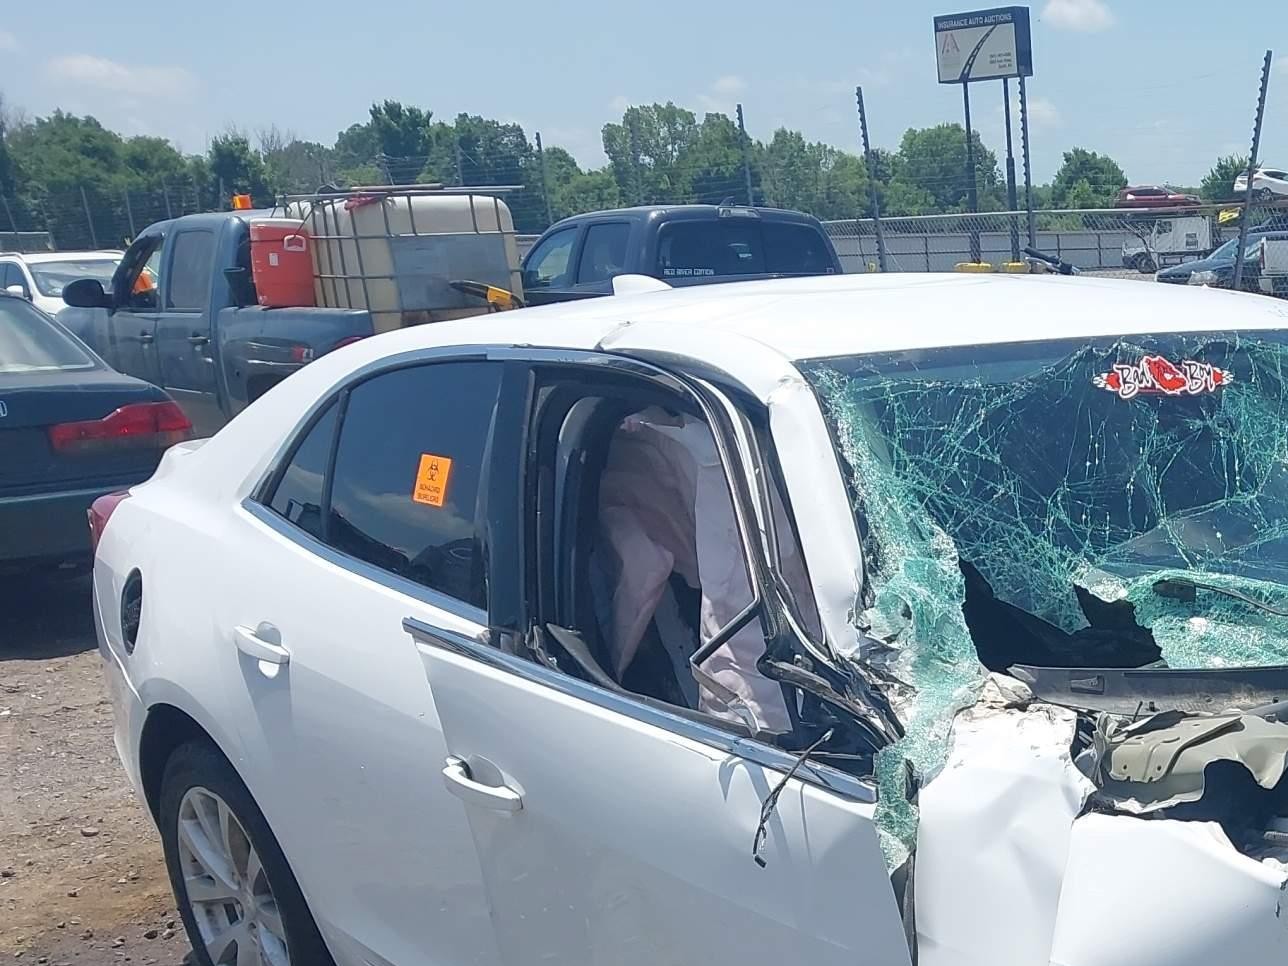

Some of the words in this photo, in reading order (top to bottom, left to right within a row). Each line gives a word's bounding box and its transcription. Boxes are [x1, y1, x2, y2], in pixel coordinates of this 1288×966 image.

[937, 18, 968, 30] INSURANCE
[968, 16, 984, 26] AUTO
[984, 13, 1012, 24] AUCTIONS
[663, 268, 676, 276] RED
[676, 268, 693, 276] RIVER
[693, 268, 715, 276] EDITION
